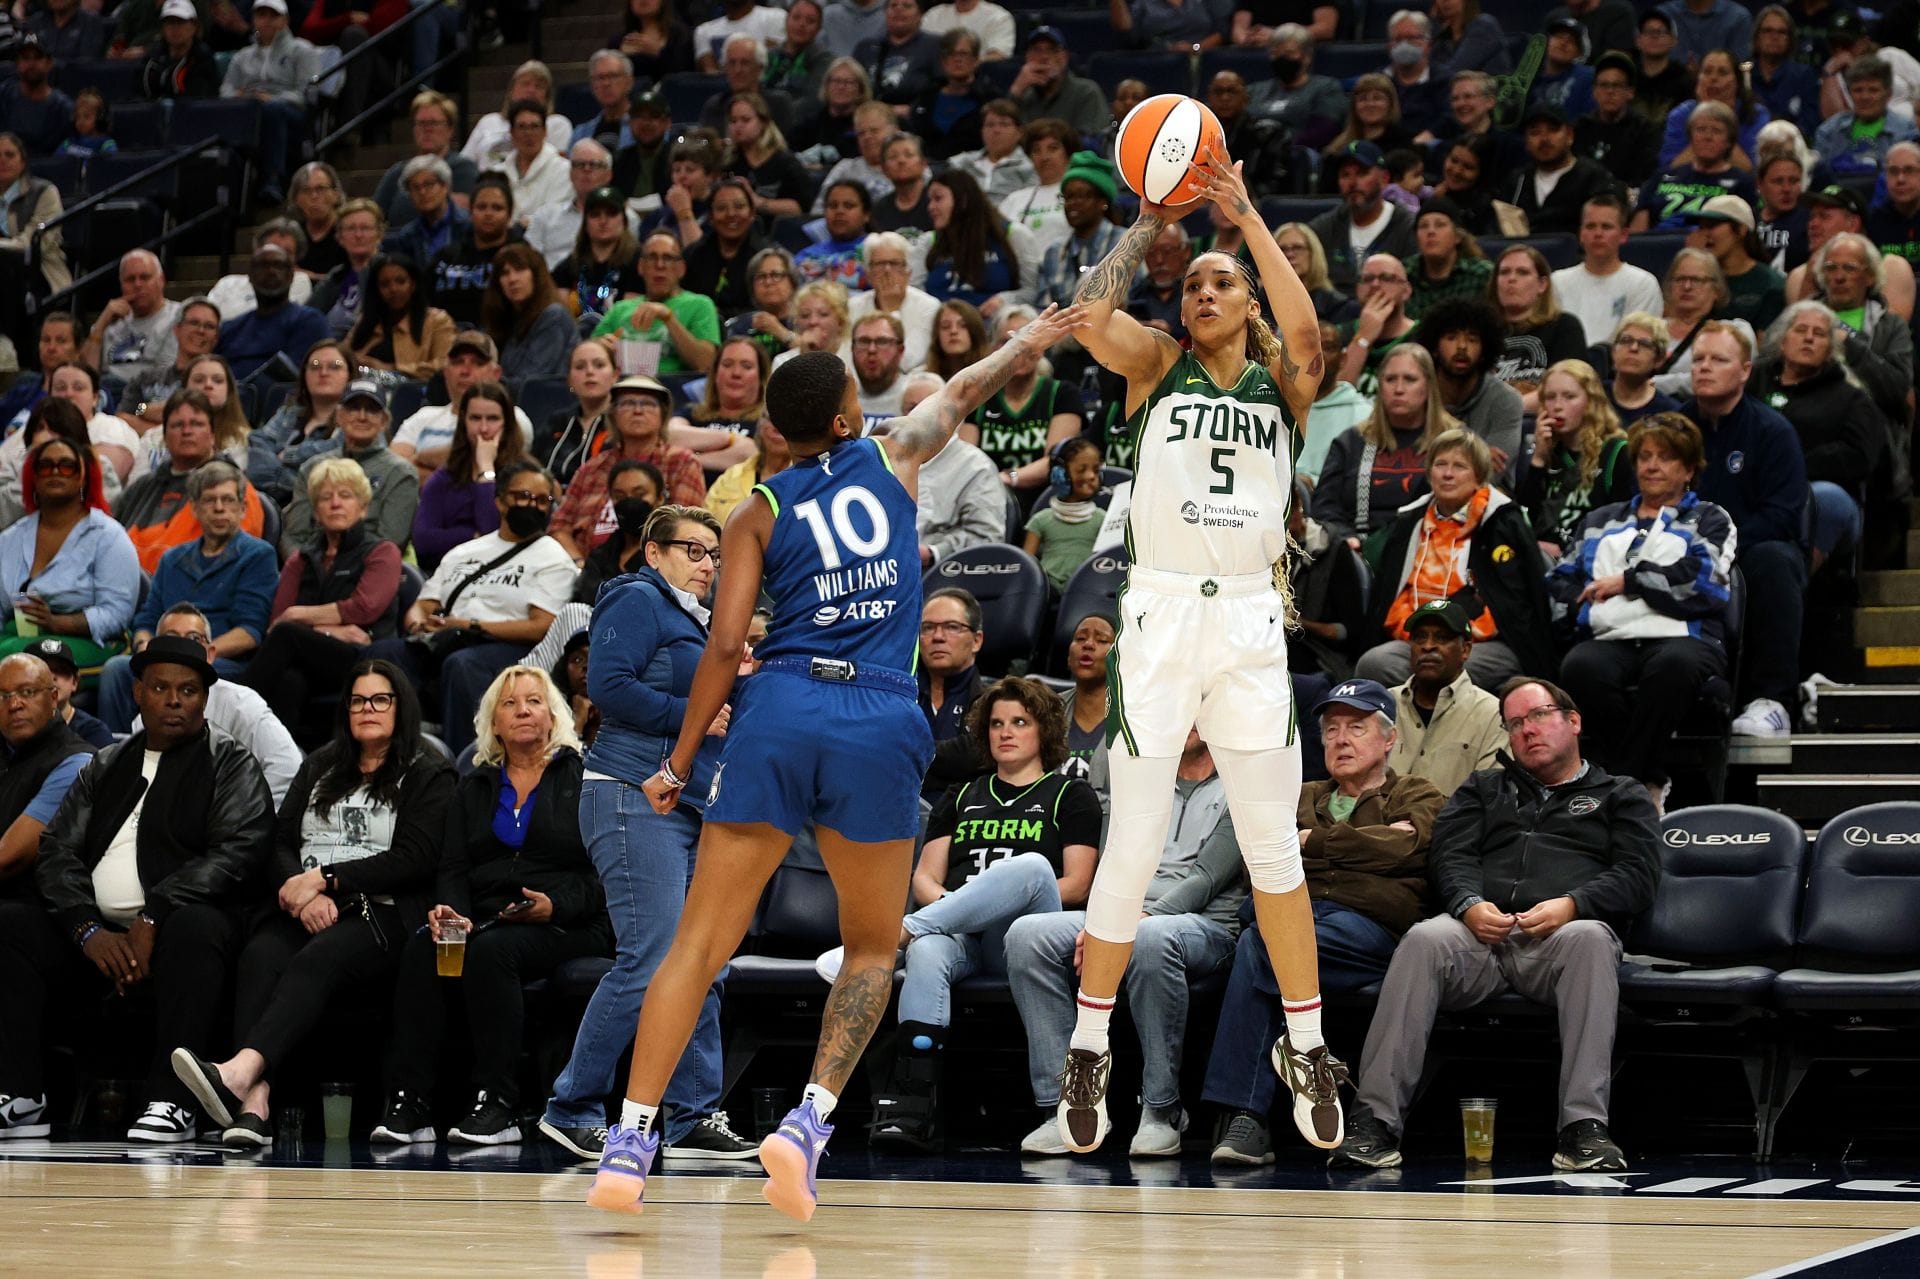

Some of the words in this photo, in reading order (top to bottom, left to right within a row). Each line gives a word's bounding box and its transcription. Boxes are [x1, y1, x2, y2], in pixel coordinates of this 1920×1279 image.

[981, 426, 1048, 451] LYNX
[1166, 403, 1277, 458] STORM
[1209, 447, 1236, 495] 5
[1203, 503, 1259, 518] Providence
[793, 485, 890, 571] 10
[1203, 518, 1244, 529] SWEDISH
[963, 563, 1022, 575] LEXUS
[814, 558, 898, 602] WILLIAMS
[842, 600, 897, 620] AT&T
[1335, 684, 1356, 697] M
[954, 819, 1043, 844] STORM
[1692, 832, 1771, 845] LEXUS
[1677, 1008, 1690, 1016] 25
[610, 1157, 639, 1171] Moolah
